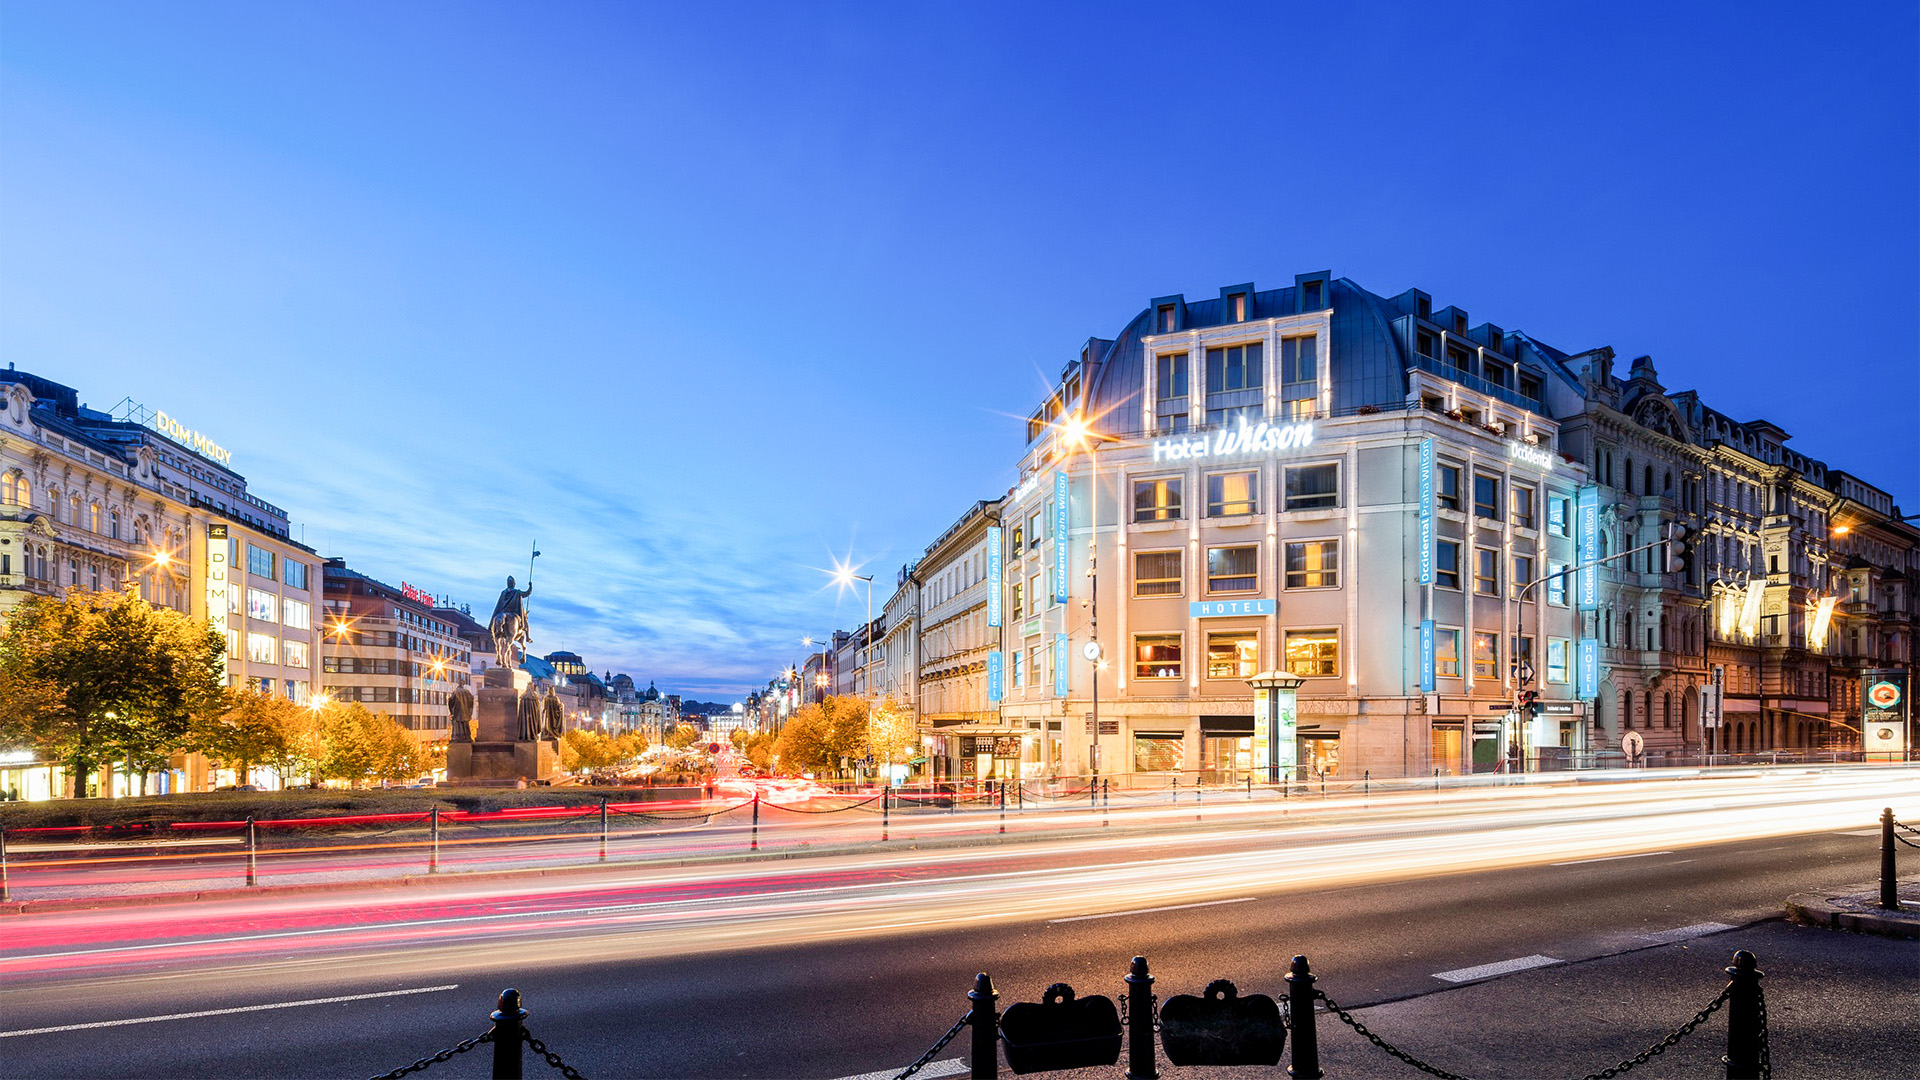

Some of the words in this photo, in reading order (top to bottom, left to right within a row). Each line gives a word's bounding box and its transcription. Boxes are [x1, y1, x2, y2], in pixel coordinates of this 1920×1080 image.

[156, 410, 190, 443] DŮM
[1153, 435, 1209, 462] Hotel
[1213, 415, 1314, 456] Wilson
[1422, 441, 1430, 482] Wilson
[1511, 442, 1552, 470] Occidental
[1422, 482, 1430, 516] Praha
[1585, 507, 1594, 536] Wilson
[1422, 518, 1430, 582] Occidental
[1585, 536, 1594, 560] Praha
[1585, 560, 1594, 605] Occidental
[1202, 602, 1264, 614] HOTEL
